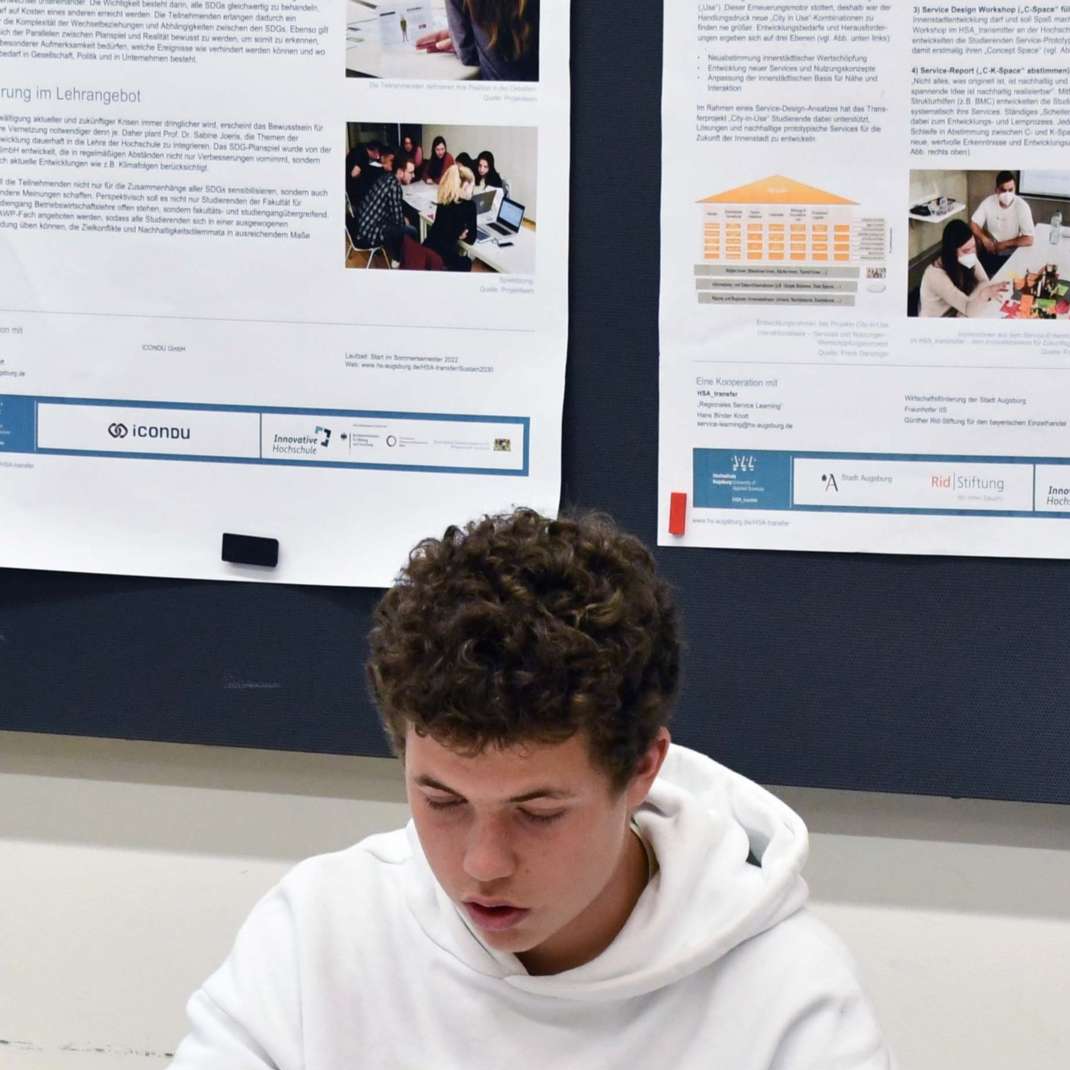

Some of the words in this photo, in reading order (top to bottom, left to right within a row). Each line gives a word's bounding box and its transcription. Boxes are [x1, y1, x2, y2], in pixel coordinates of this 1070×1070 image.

[914, 5, 920, 14] 3)
[922, 5, 948, 13] Service
[951, 5, 976, 15] Design
[978, 6, 1015, 14] Workshop
[911, 66, 918, 75] 4)
[920, 66, 974, 75] Service-Report
[36, 85, 52, 99] im
[56, 87, 140, 105] Lehrangebot
[696, 376, 713, 386] Eine
[715, 377, 763, 387] Kooperation
[765, 378, 778, 387] mit
[274, 434, 318, 445] Innovative
[272, 445, 317, 455] Hochschule
[841, 473, 858, 481] Stadt
[860, 474, 892, 483] Augsburg
[931, 474, 950, 490] Rid
[957, 475, 1005, 492] Stiftung
